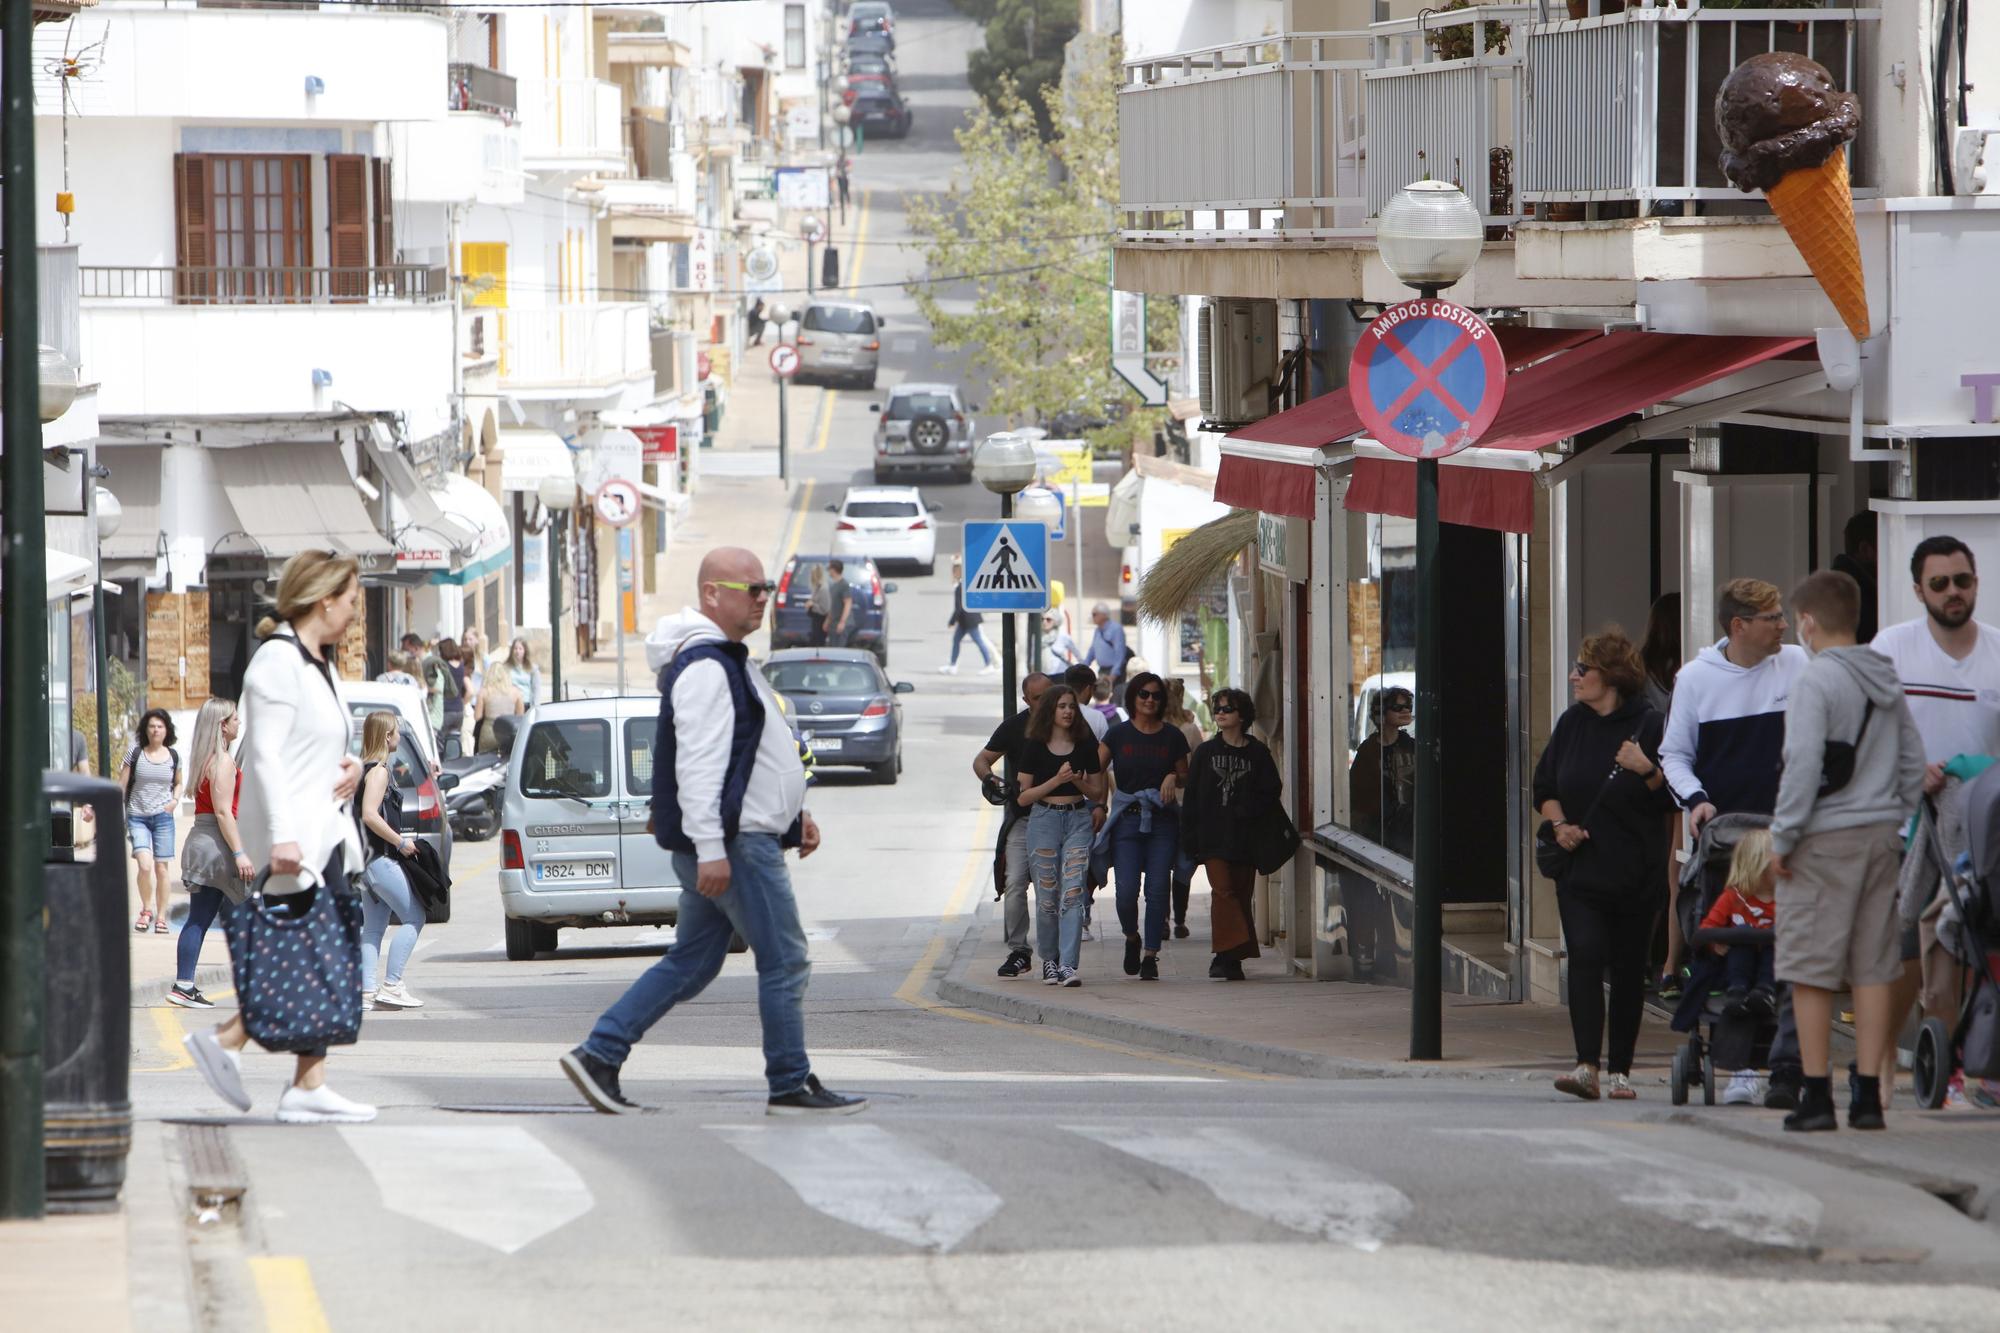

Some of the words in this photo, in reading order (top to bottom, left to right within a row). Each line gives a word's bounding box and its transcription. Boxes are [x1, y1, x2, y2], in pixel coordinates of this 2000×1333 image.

[1372, 300, 1427, 339] AMBDÓS
[1432, 303, 1486, 340] COSTATS
[534, 824, 585, 834] CITROËN
[544, 864, 575, 878] 3624
[586, 863, 609, 877] DCN
